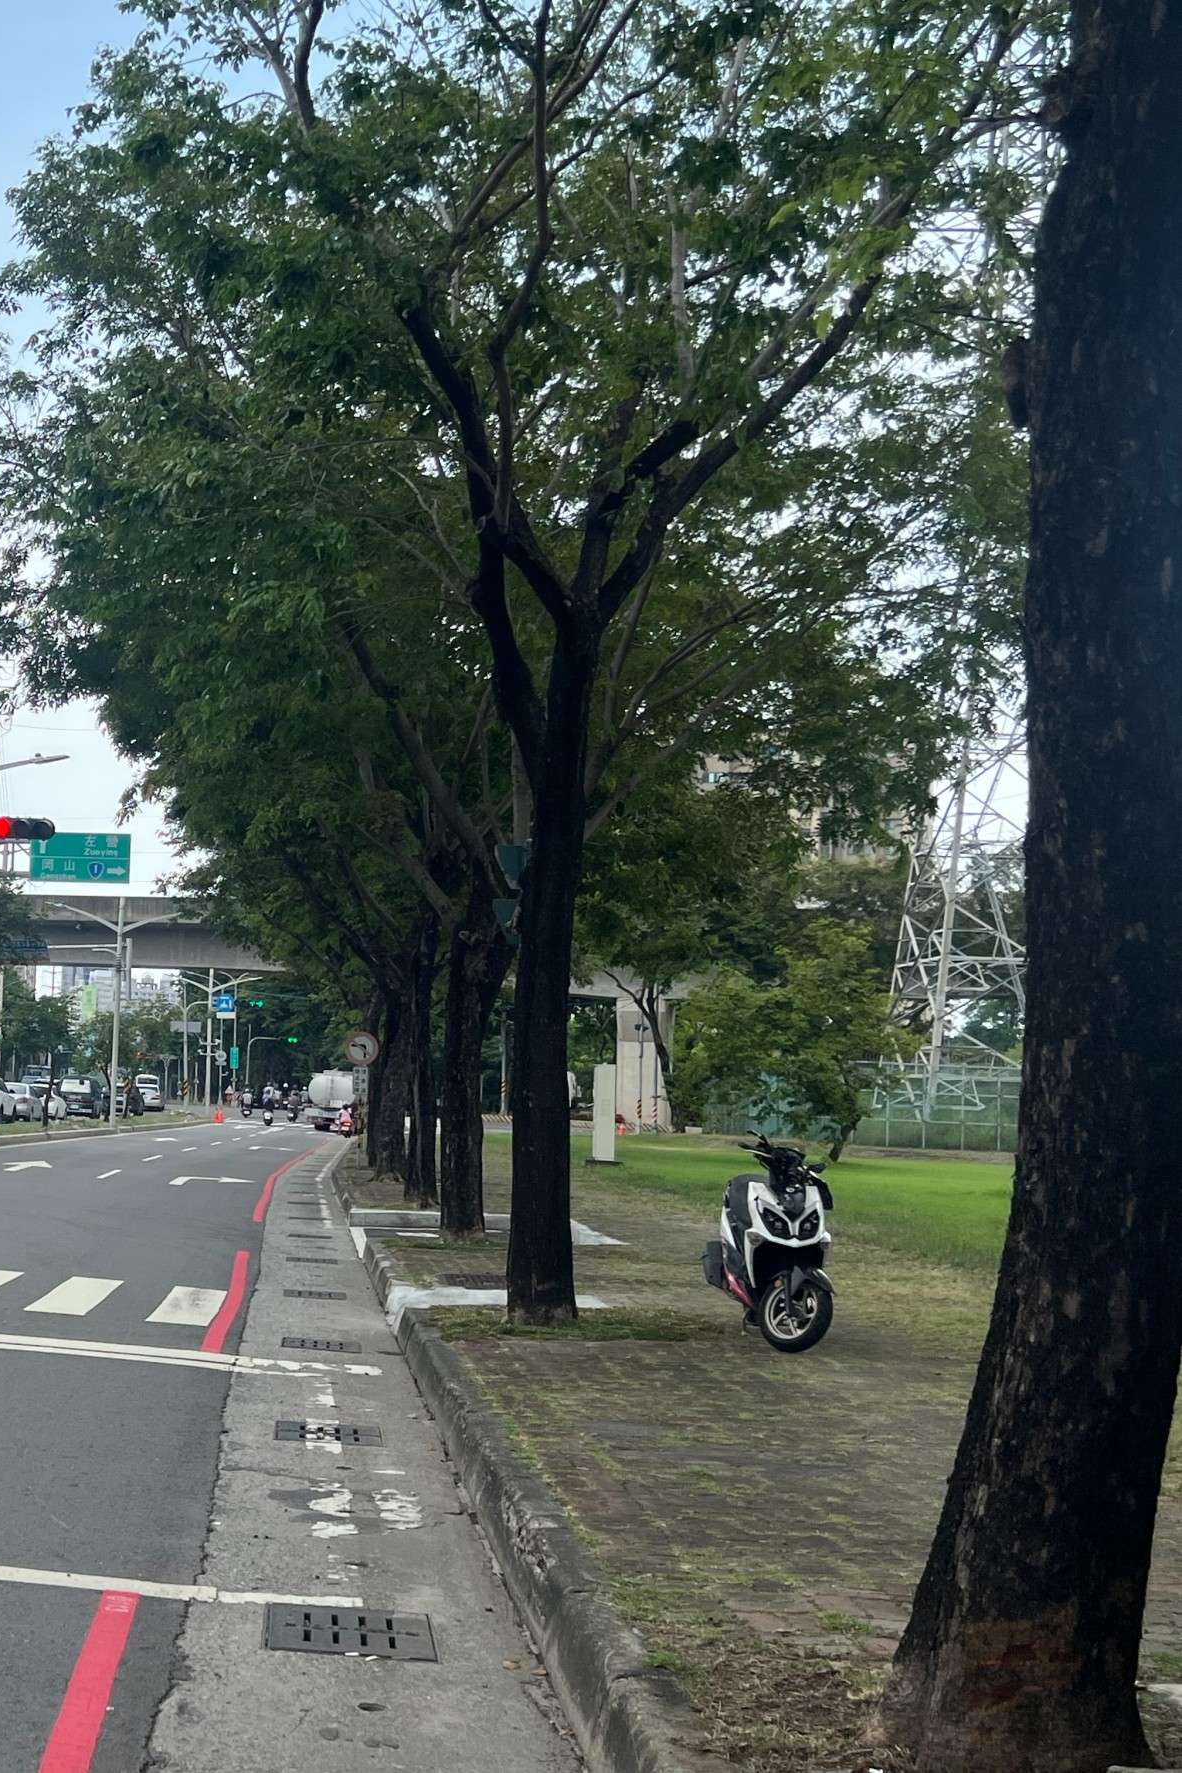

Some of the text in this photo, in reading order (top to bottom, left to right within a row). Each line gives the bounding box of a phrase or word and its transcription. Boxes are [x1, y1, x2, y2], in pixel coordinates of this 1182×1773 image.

[83, 834, 119, 848] 左營
[82, 848, 118, 857] Zuoying
[41, 858, 75, 872] 岡山
